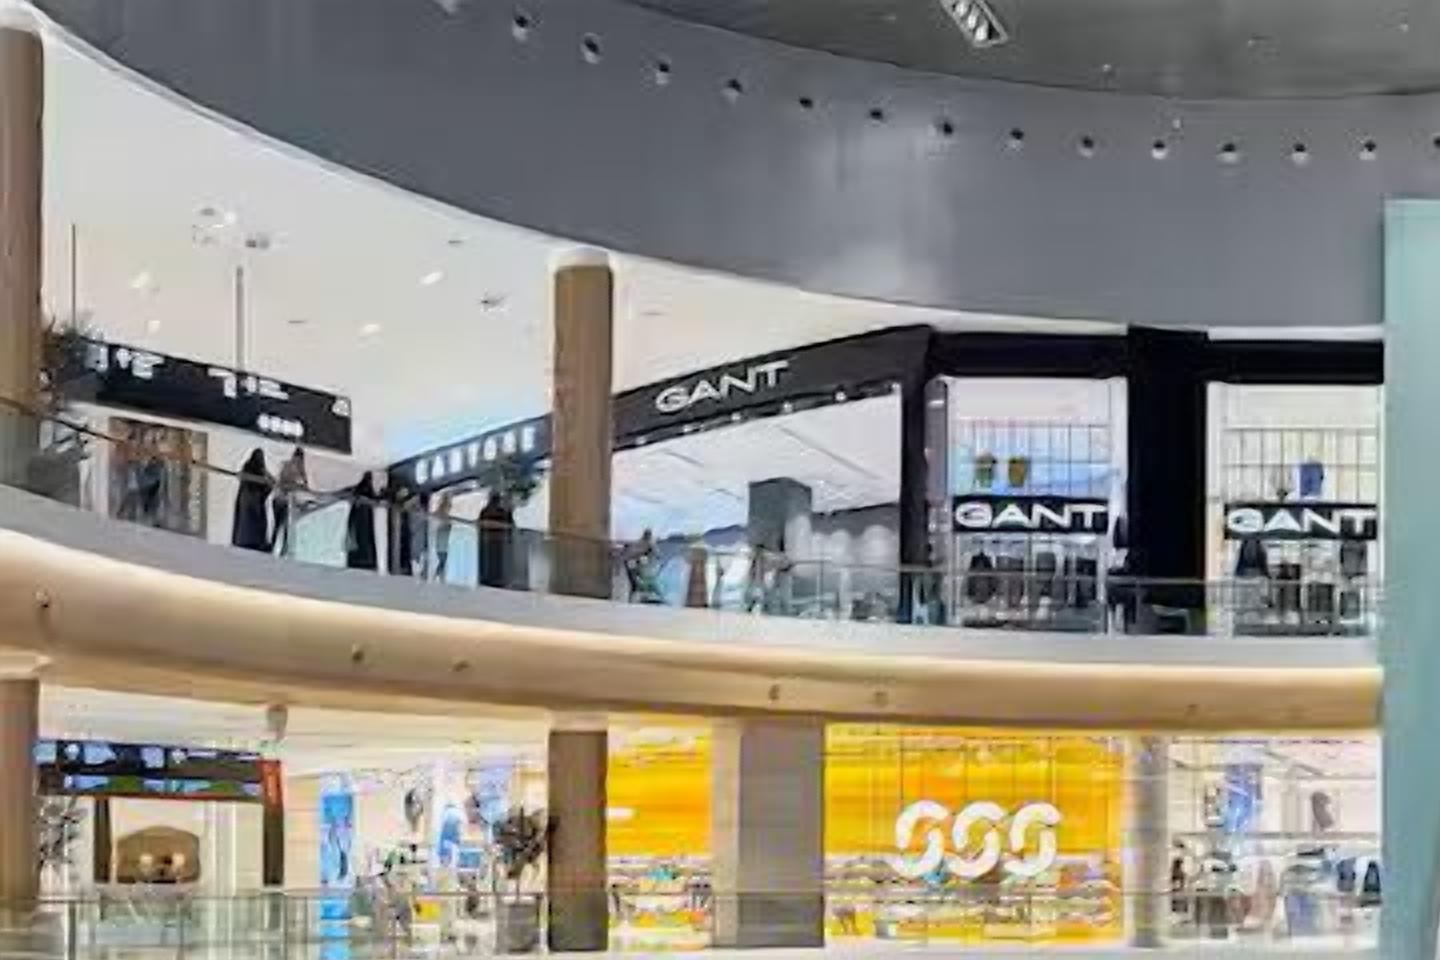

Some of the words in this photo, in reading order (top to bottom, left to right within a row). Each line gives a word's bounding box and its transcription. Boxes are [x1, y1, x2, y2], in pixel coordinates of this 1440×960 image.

[655, 360, 789, 412] GANT
[955, 502, 1107, 528] GANT
[1228, 508, 1377, 534] GANT
